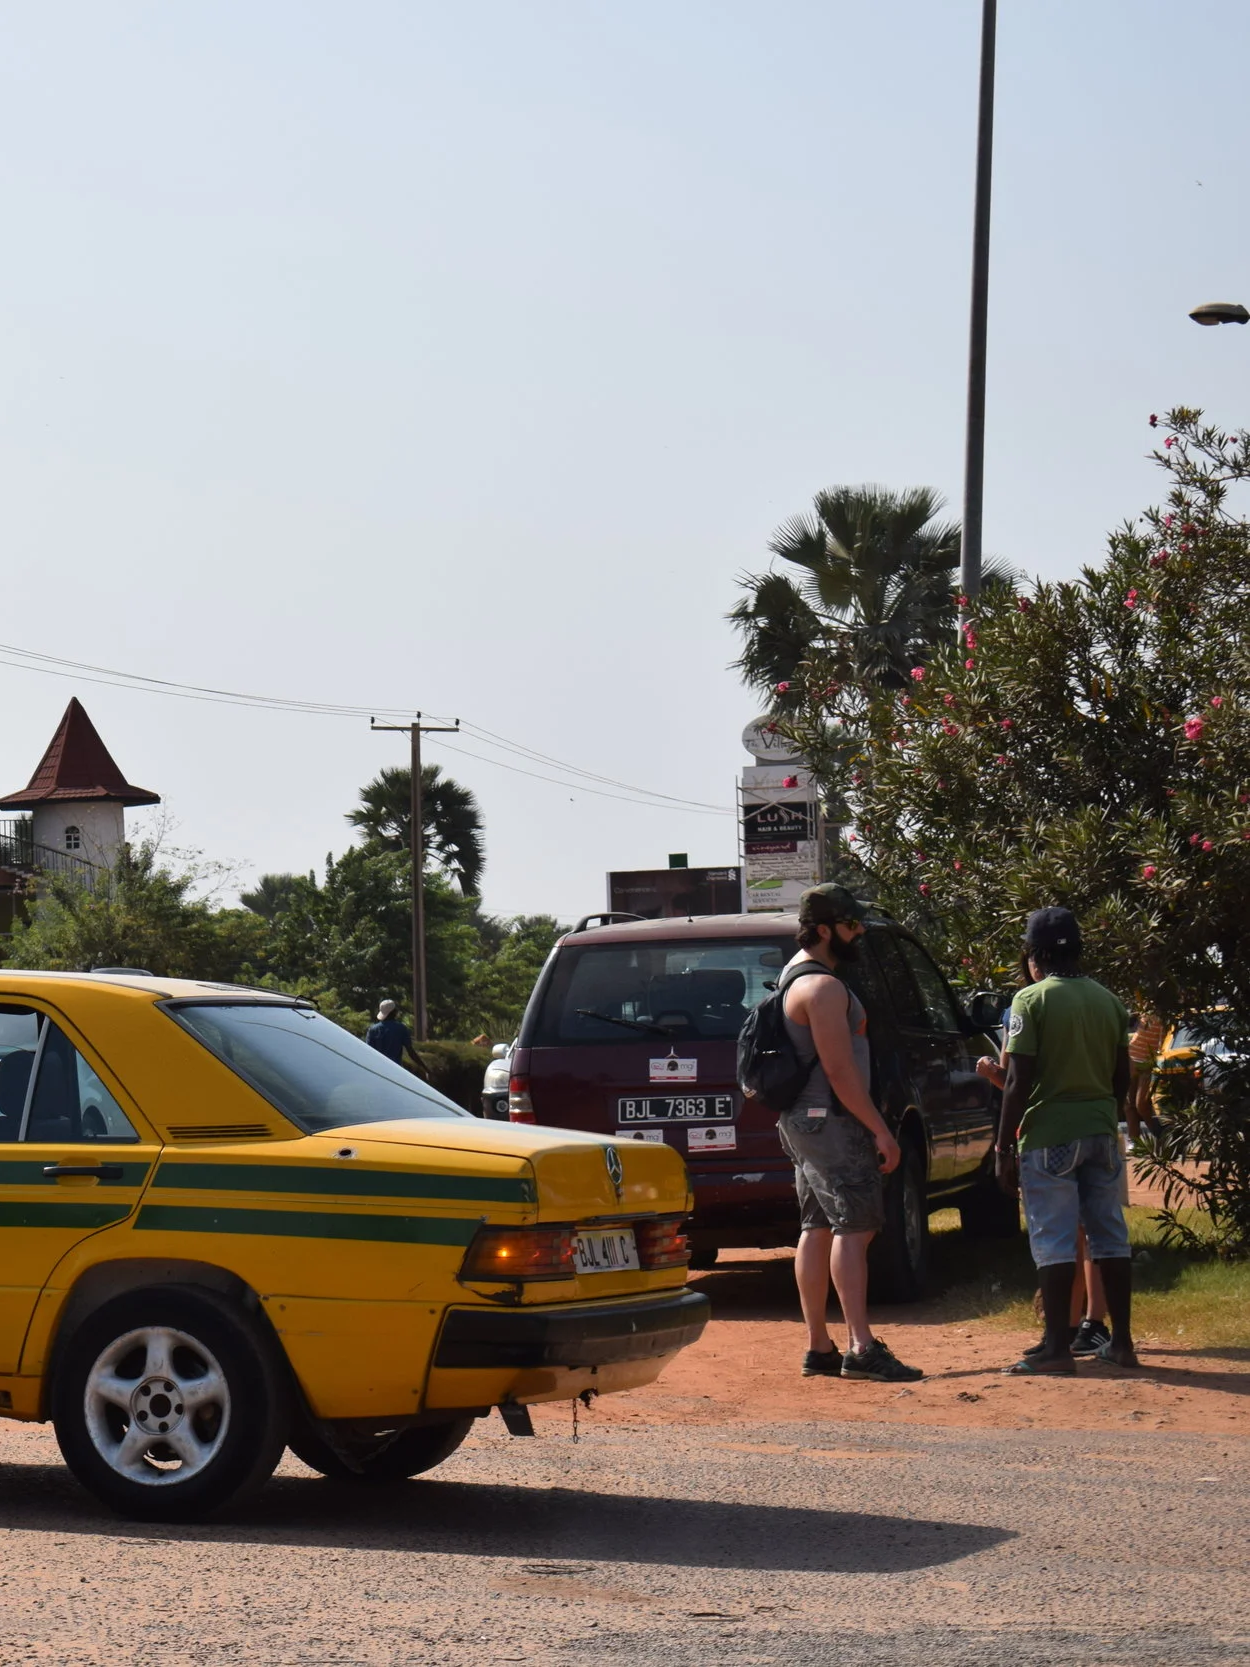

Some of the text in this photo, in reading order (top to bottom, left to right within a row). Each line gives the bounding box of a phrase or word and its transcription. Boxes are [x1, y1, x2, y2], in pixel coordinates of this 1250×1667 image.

[626, 1098, 725, 1118] BJL 7363 E
[577, 1236, 599, 1267] BJL
[620, 1236, 629, 1264] C
